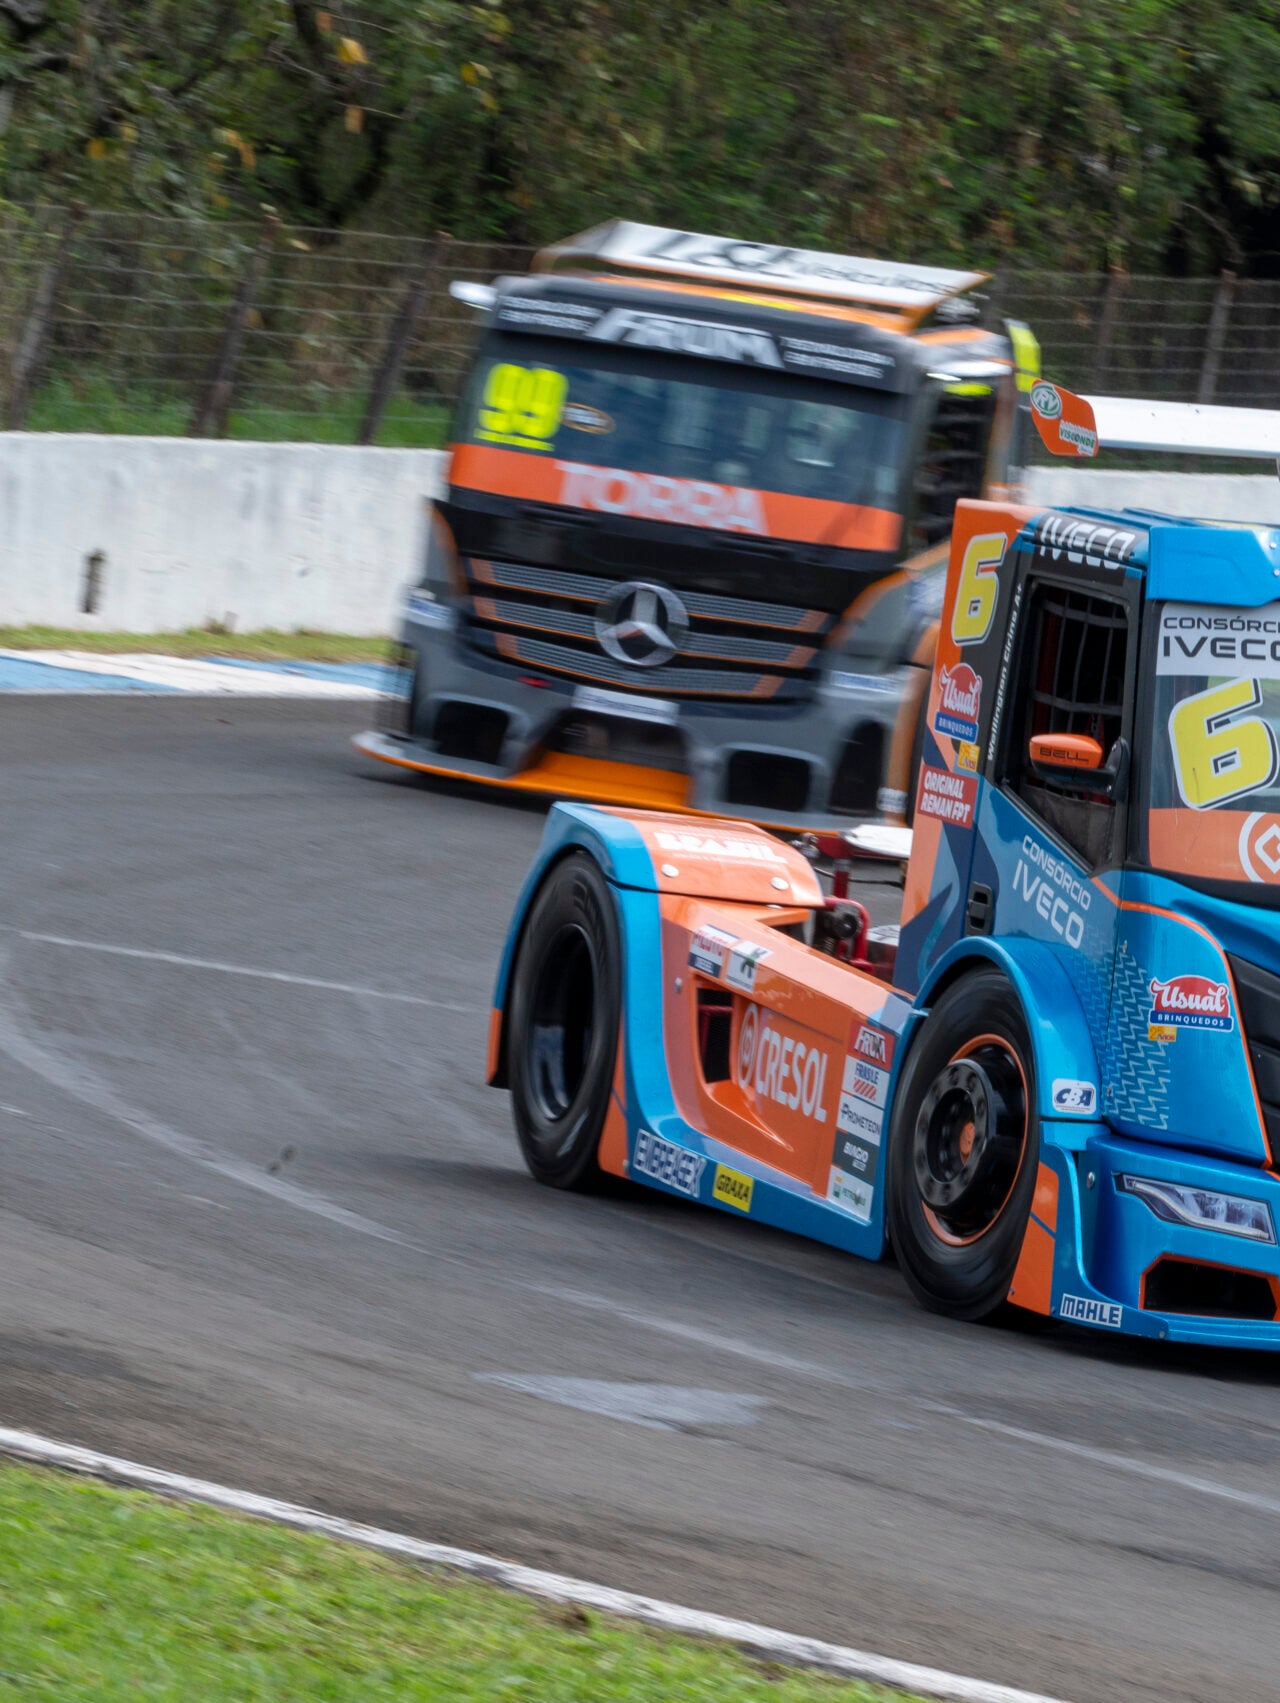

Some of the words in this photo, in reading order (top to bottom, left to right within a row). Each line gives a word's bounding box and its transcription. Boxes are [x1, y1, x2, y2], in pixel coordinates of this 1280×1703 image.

[478, 363, 569, 439] 99
[555, 460, 769, 536] TORRA
[1040, 515, 1135, 571] IVECO
[951, 532, 1008, 646] 6
[940, 675, 981, 717] Usual
[1039, 746, 1089, 763] BELL
[1168, 675, 1280, 812] 6
[924, 771, 965, 799] ORIGINAL
[920, 792, 953, 818] REMAN
[951, 801, 972, 824] FPT
[1022, 835, 1092, 911] CONSÓRCIO
[1012, 859, 1084, 949] IVECO
[1152, 982, 1227, 1013] Usual
[1157, 1013, 1225, 1027] BRINQUEDOS
[755, 1026, 828, 1123] CRESOL
[1056, 1087, 1092, 1107] CBA
[841, 1103, 880, 1135] PROMETEON
[716, 1174, 751, 1203] GRAXA
[1062, 1296, 1121, 1325] MAHLE
